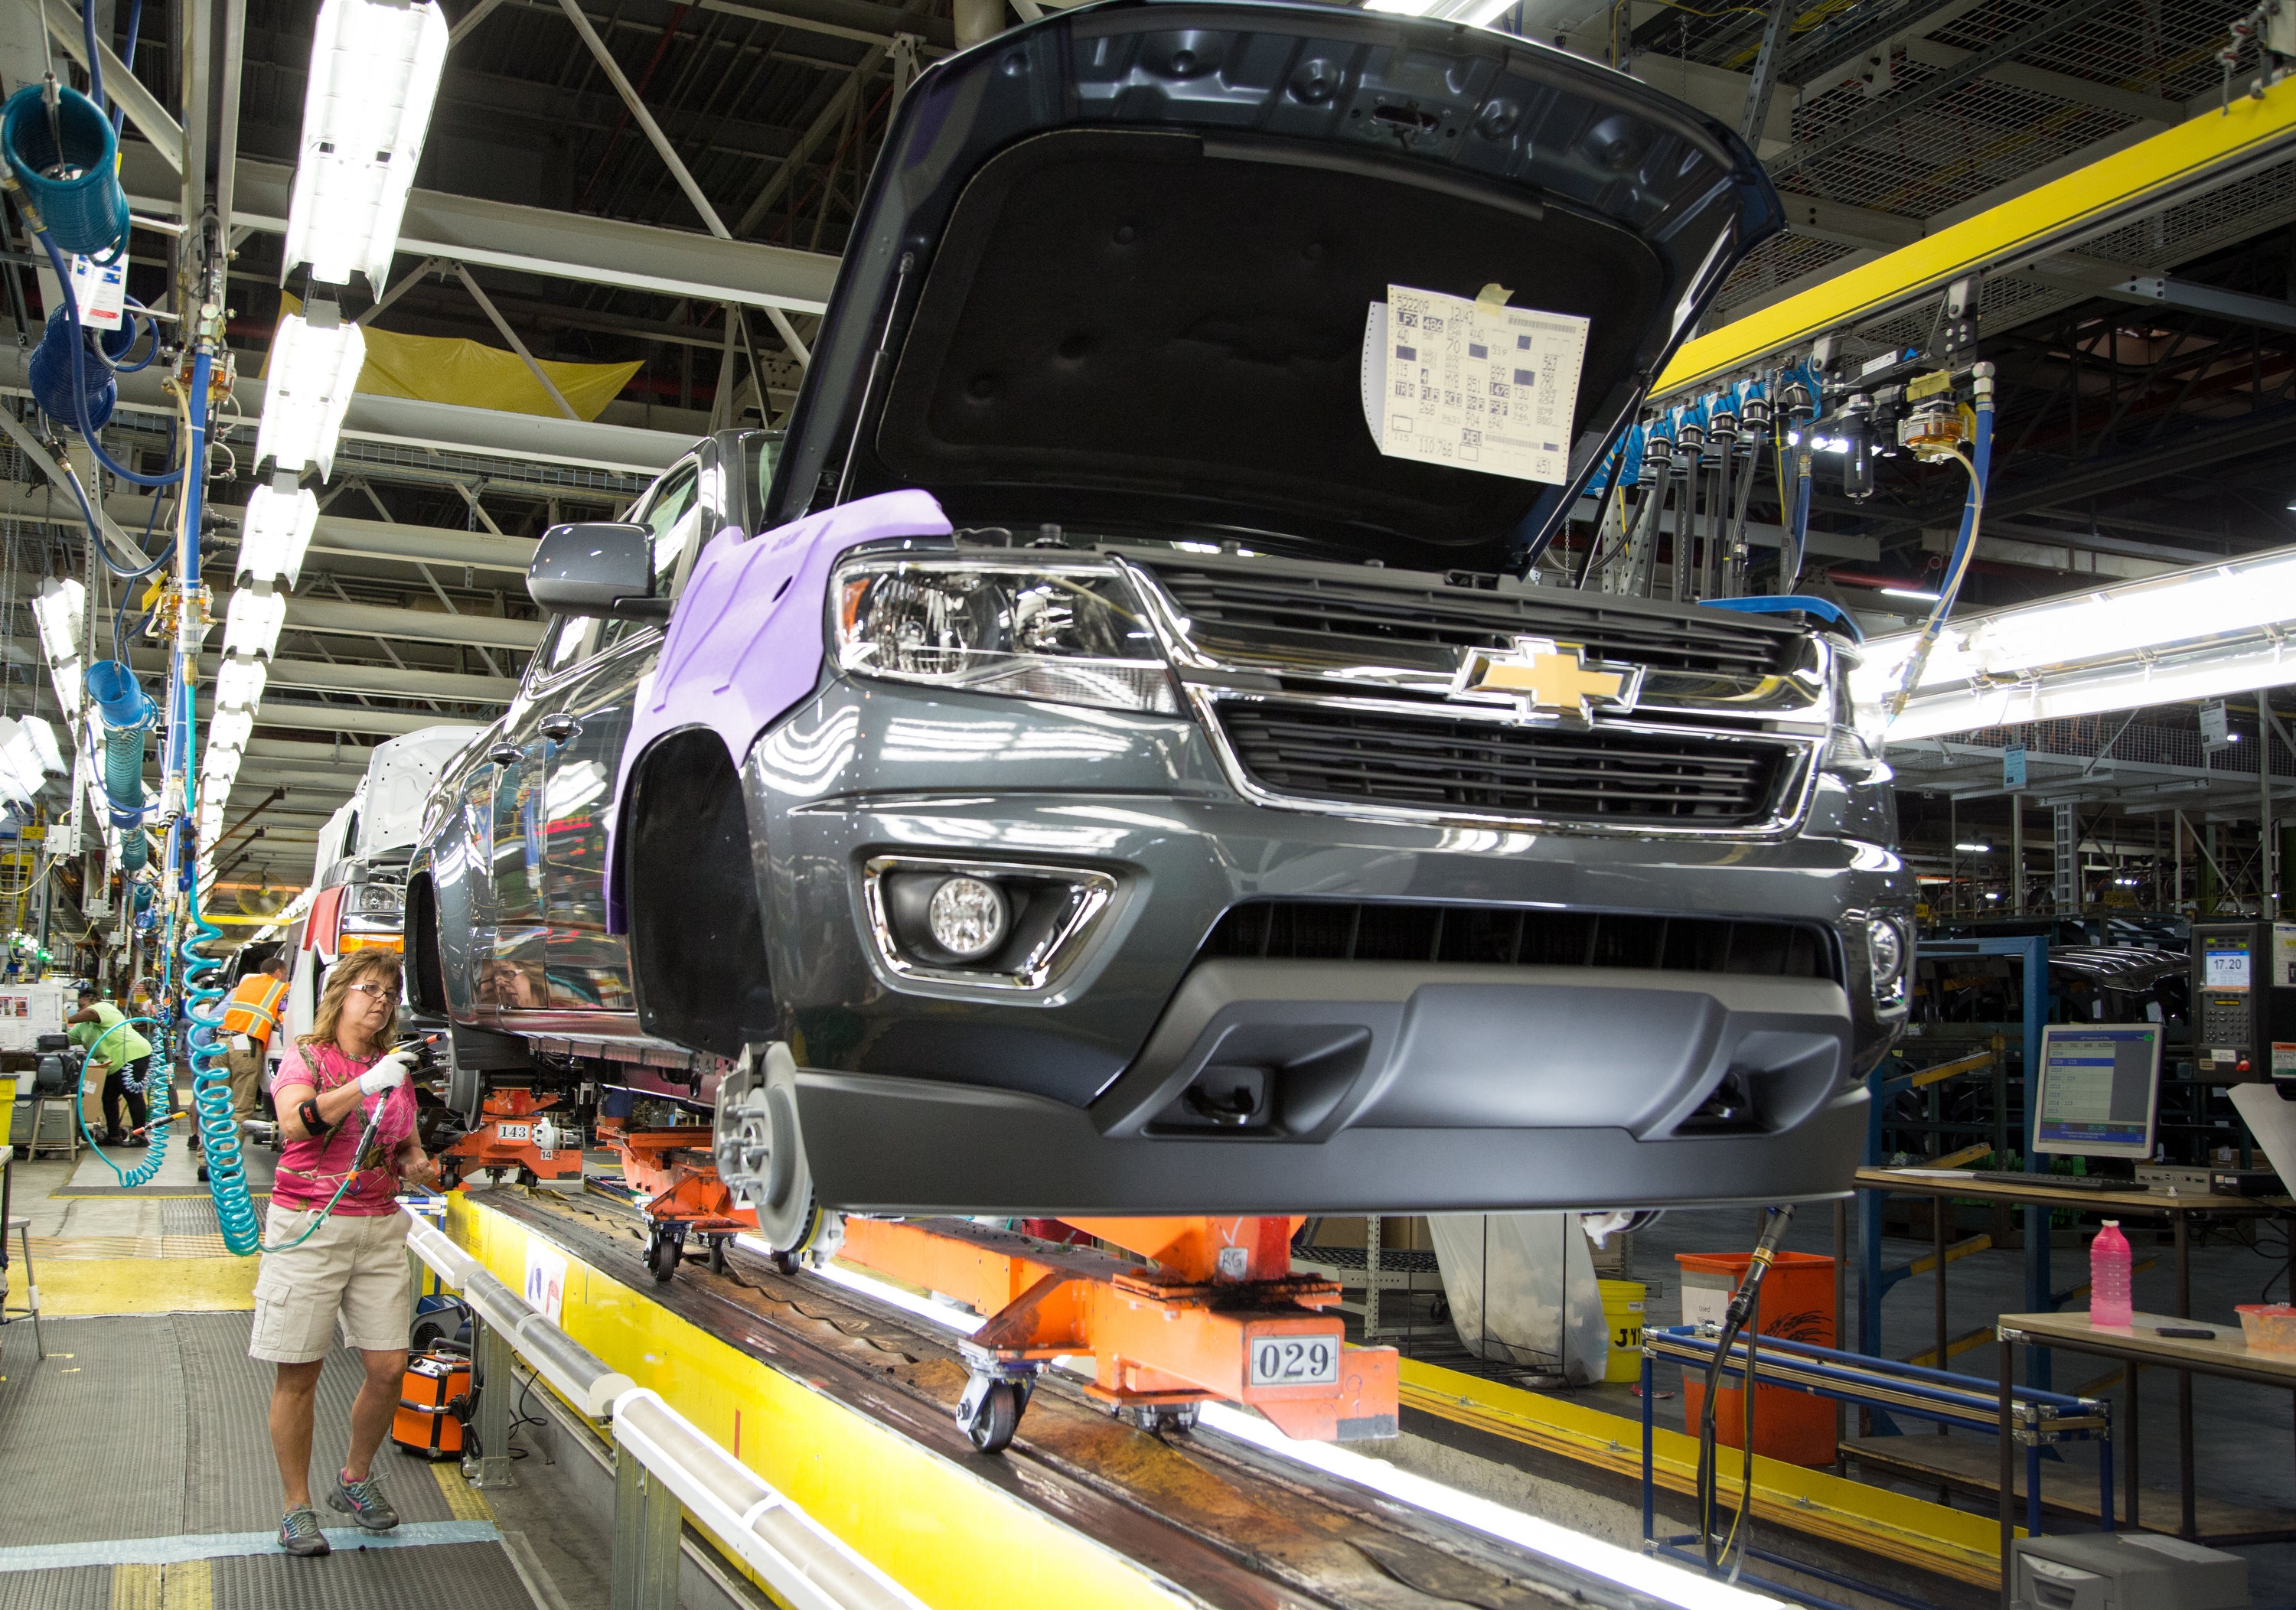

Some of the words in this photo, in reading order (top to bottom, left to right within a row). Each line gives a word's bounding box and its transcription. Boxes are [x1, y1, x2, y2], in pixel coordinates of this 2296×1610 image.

[1397, 295, 1430, 315] 522209
[1397, 312, 1417, 327] LFX
[1424, 318, 1443, 333] 486
[1446, 337, 1460, 354] 70
[2213, 959, 2242, 970] 17.20
[304, 1106, 316, 1123] ACE
[501, 1126, 526, 1138] 143
[1698, 1305, 1711, 1313] Used
[1260, 1343, 1329, 1378] 029
